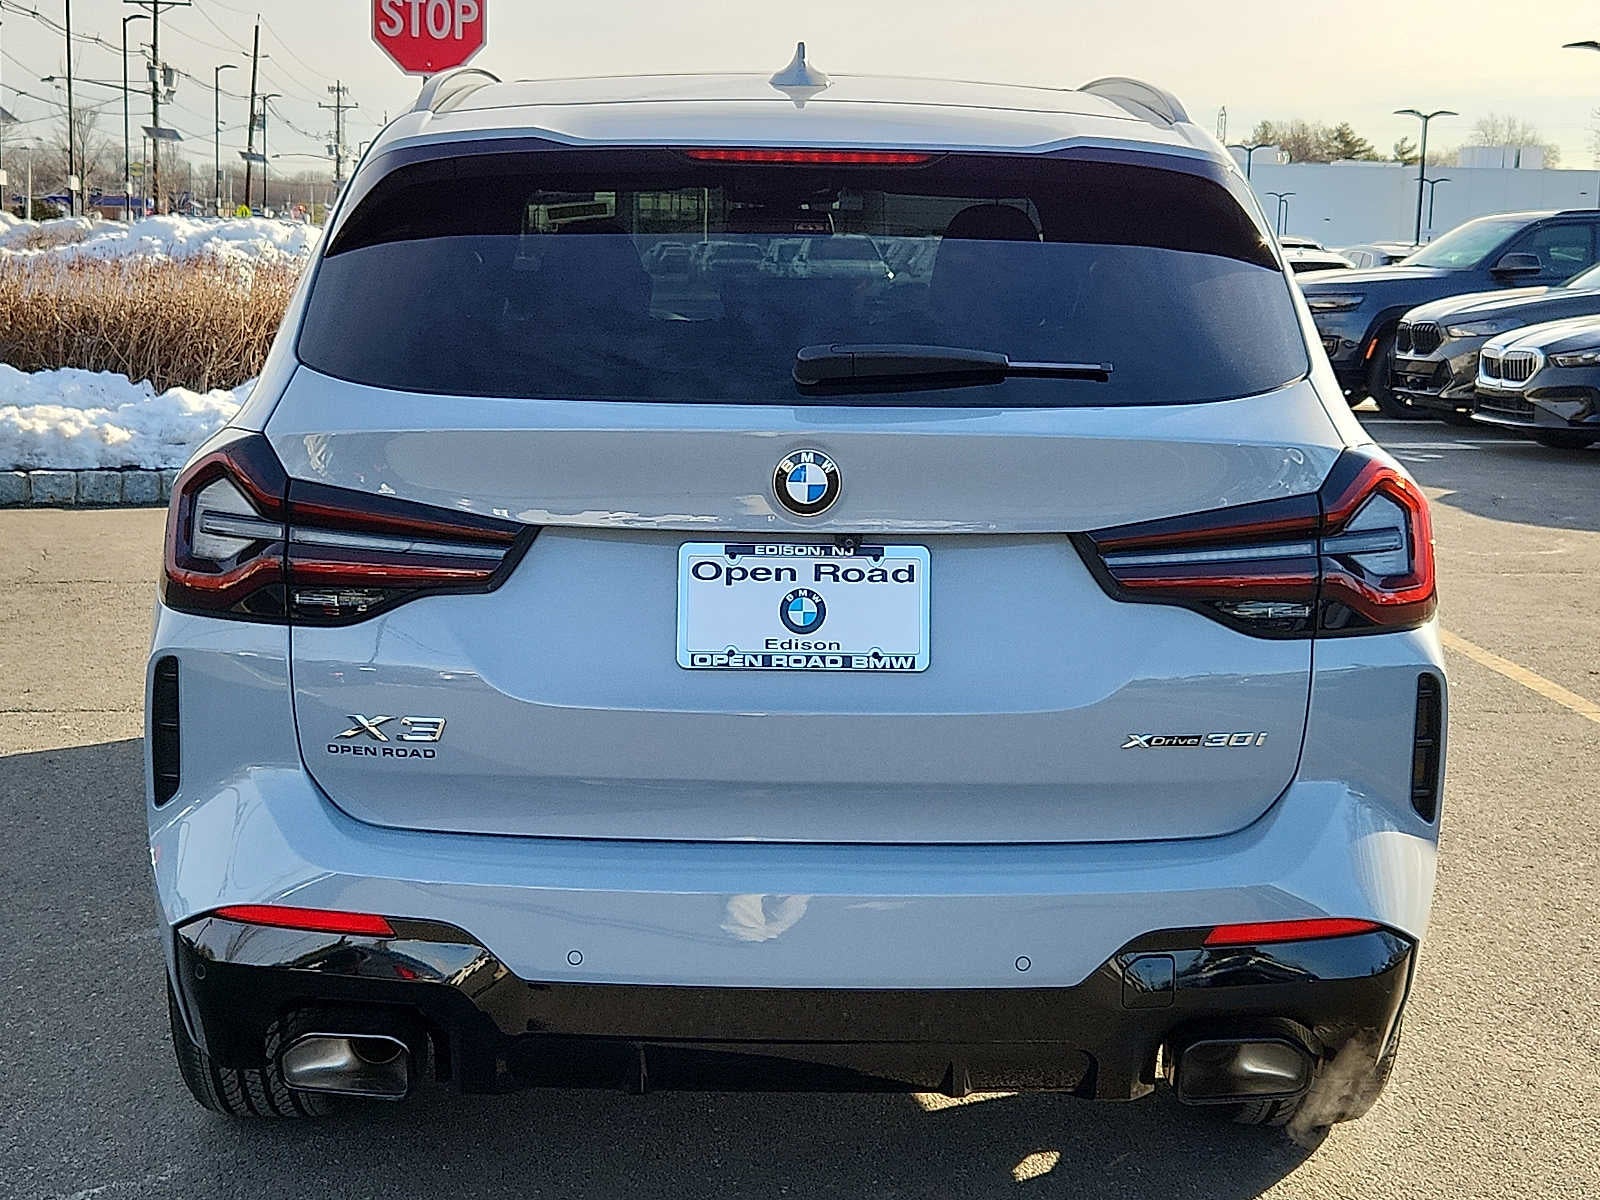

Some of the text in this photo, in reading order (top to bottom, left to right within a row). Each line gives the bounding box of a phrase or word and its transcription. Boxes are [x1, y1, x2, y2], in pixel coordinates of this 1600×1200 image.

[379, 0, 479, 40] STOP
[780, 452, 835, 474] BMW
[754, 545, 825, 556] EDISON,
[691, 561, 916, 586] Open Road
[786, 589, 822, 604] BMW
[765, 638, 841, 652] Edison
[693, 654, 914, 670] OPEN ROAD BMW
[333, 713, 447, 742] X3
[327, 744, 436, 759] OPEN ROAD
